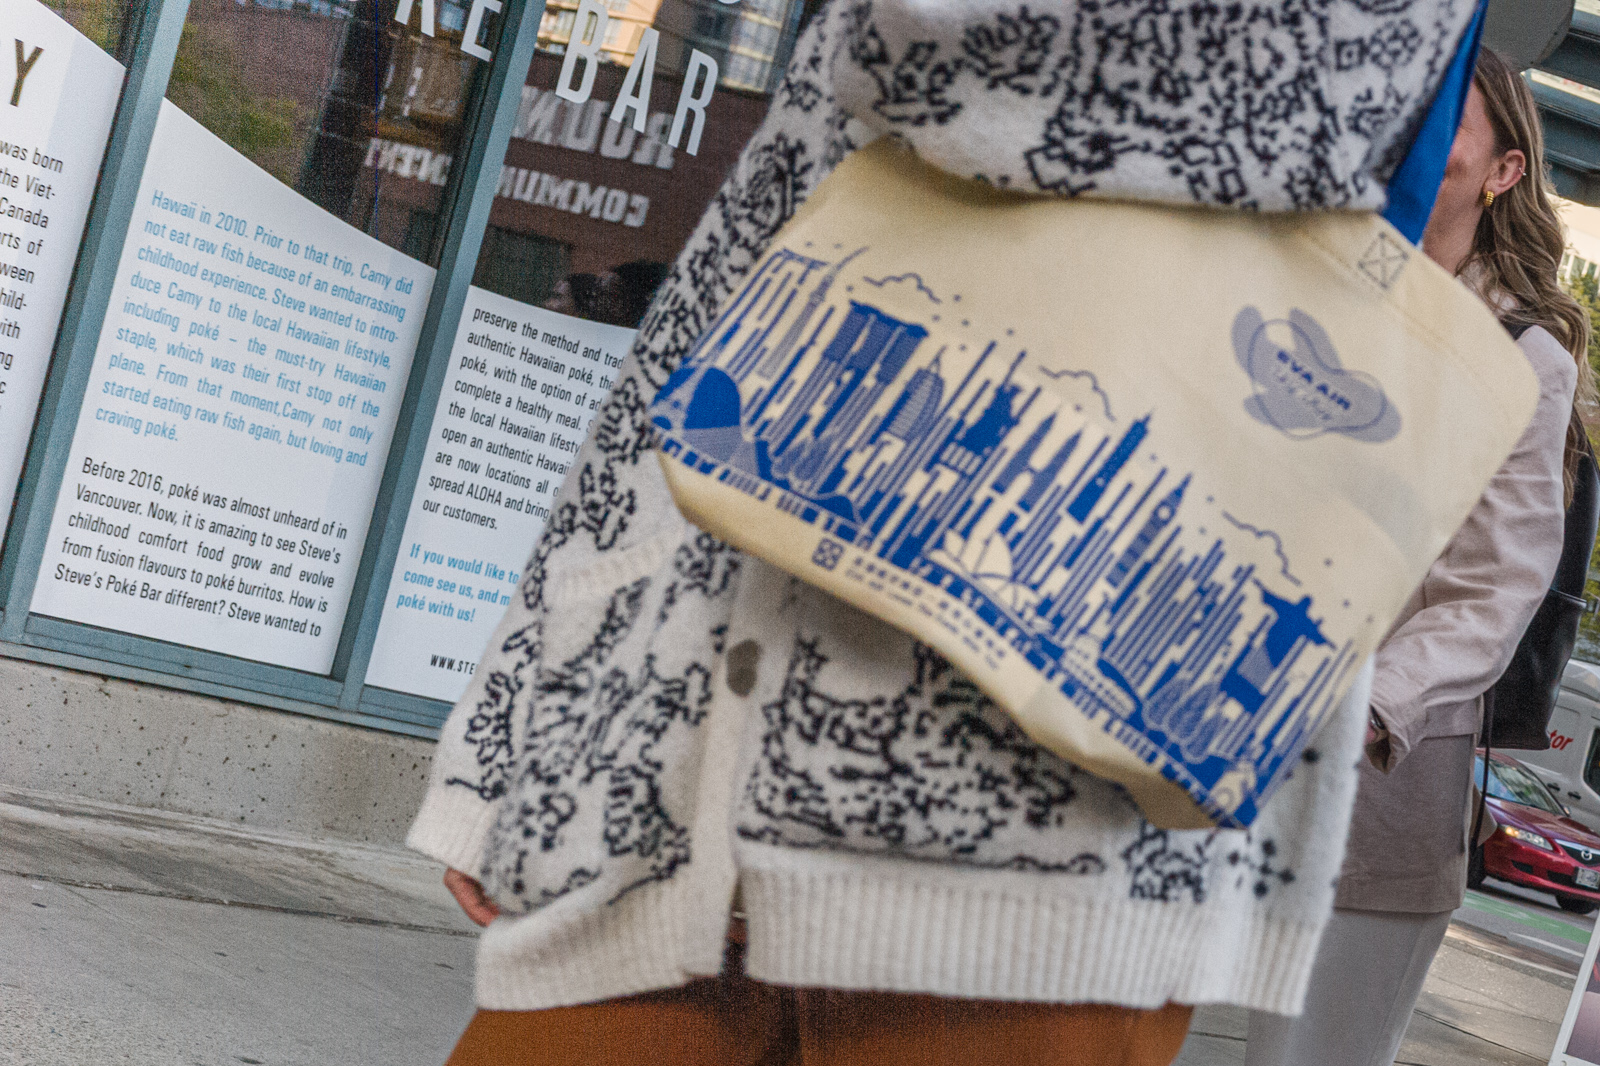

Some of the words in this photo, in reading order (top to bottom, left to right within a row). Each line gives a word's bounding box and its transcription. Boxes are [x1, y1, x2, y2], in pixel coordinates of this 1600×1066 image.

[555, 0, 718, 156] BAR
[32, 147, 64, 173] born
[26, 174, 55, 200] Viet-
[0, 196, 49, 229] Canada
[26, 239, 44, 256] of
[152, 190, 197, 219] Hawaii
[199, 206, 211, 224] in
[215, 212, 248, 237] 2010.
[254, 225, 283, 248] Prior
[288, 240, 300, 255] to
[304, 245, 329, 266] that
[333, 256, 354, 276] trip,
[360, 263, 392, 290] Camy
[395, 277, 413, 294] did
[138, 246, 199, 277] childhood
[201, 269, 267, 301] experience.
[272, 288, 306, 312] Steve
[309, 305, 353, 328] wanted
[355, 318, 366, 333] to
[369, 321, 398, 342] intro-
[144, 221, 167, 238] not
[169, 229, 190, 246] eat
[193, 238, 217, 254] raw
[221, 242, 244, 264] fish
[246, 251, 296, 282] because
[298, 272, 312, 286] of
[314, 279, 328, 292] an
[331, 285, 406, 323] embarrassing
[123, 297, 180, 332] including
[188, 322, 219, 341] poké
[247, 337, 266, 355] the
[275, 349, 325, 376] must-try
[334, 363, 386, 392] Hawaiian
[467, 332, 516, 357] authentic
[519, 346, 565, 374] Hawaiian
[568, 367, 593, 386] poké,
[472, 308, 517, 332] preserve
[522, 323, 538, 340] the
[541, 332, 580, 354] method
[582, 347, 602, 362] and
[455, 380, 501, 404] complete
[505, 397, 512, 408] a
[516, 396, 553, 423] healthy
[556, 413, 581, 430] meal.
[460, 356, 487, 376] poké,
[494, 366, 517, 383] with
[521, 374, 537, 390] the
[541, 383, 571, 402] option
[575, 393, 587, 406] of
[96, 408, 142, 434] craving
[144, 422, 177, 441] poké.
[442, 428, 467, 444] open
[470, 437, 483, 449] an
[486, 442, 533, 465] authentic
[449, 402, 466, 418] the
[470, 408, 496, 427] local
[499, 417, 545, 443] Hawaiian
[82, 457, 125, 482] Before
[128, 469, 163, 494] 2016,
[168, 484, 199, 501] poké
[203, 493, 227, 509] was
[230, 497, 270, 520] almost
[273, 510, 320, 532] unheard
[322, 521, 335, 536] of
[336, 523, 347, 539] in
[435, 452, 452, 466] are
[457, 459, 480, 474] now
[485, 464, 531, 489] locations
[536, 480, 549, 494] all
[77, 484, 142, 515] Vancouver.
[147, 502, 177, 525] Now,
[182, 510, 192, 527] it
[195, 514, 205, 530] is
[208, 521, 257, 547] amazing
[261, 532, 273, 547] to
[276, 538, 296, 553] see
[423, 500, 441, 513] our
[443, 505, 497, 529] customers.
[429, 476, 465, 495] spread
[466, 484, 502, 505] ALOHA
[504, 498, 524, 511] and
[525, 500, 550, 523] bring
[62, 537, 92, 558] from
[96, 545, 134, 568] fusion
[138, 555, 187, 580] flavours
[191, 569, 203, 584] to
[205, 574, 235, 591] poké
[237, 578, 284, 603] burritos.
[289, 590, 316, 609] How
[318, 596, 328, 612] is
[68, 512, 131, 539] childhood
[138, 532, 188, 553] comfort
[197, 541, 225, 562] food
[231, 554, 262, 570] grow
[270, 563, 293, 578] and
[299, 570, 334, 588] evolve
[410, 544, 421, 558] If
[423, 551, 444, 565] you
[447, 557, 483, 574] would
[485, 563, 505, 580] like
[106, 575, 137, 596] Poké
[140, 582, 162, 601] Bar
[165, 589, 226, 615] different?
[228, 602, 261, 623] Steve
[264, 615, 308, 633] wanted
[310, 623, 321, 637] to
[396, 594, 425, 610] poké
[428, 601, 454, 617] with
[457, 608, 475, 622] us!
[404, 571, 434, 587] come
[436, 579, 456, 593] see
[459, 585, 474, 599] us,
[478, 589, 499, 603] and
